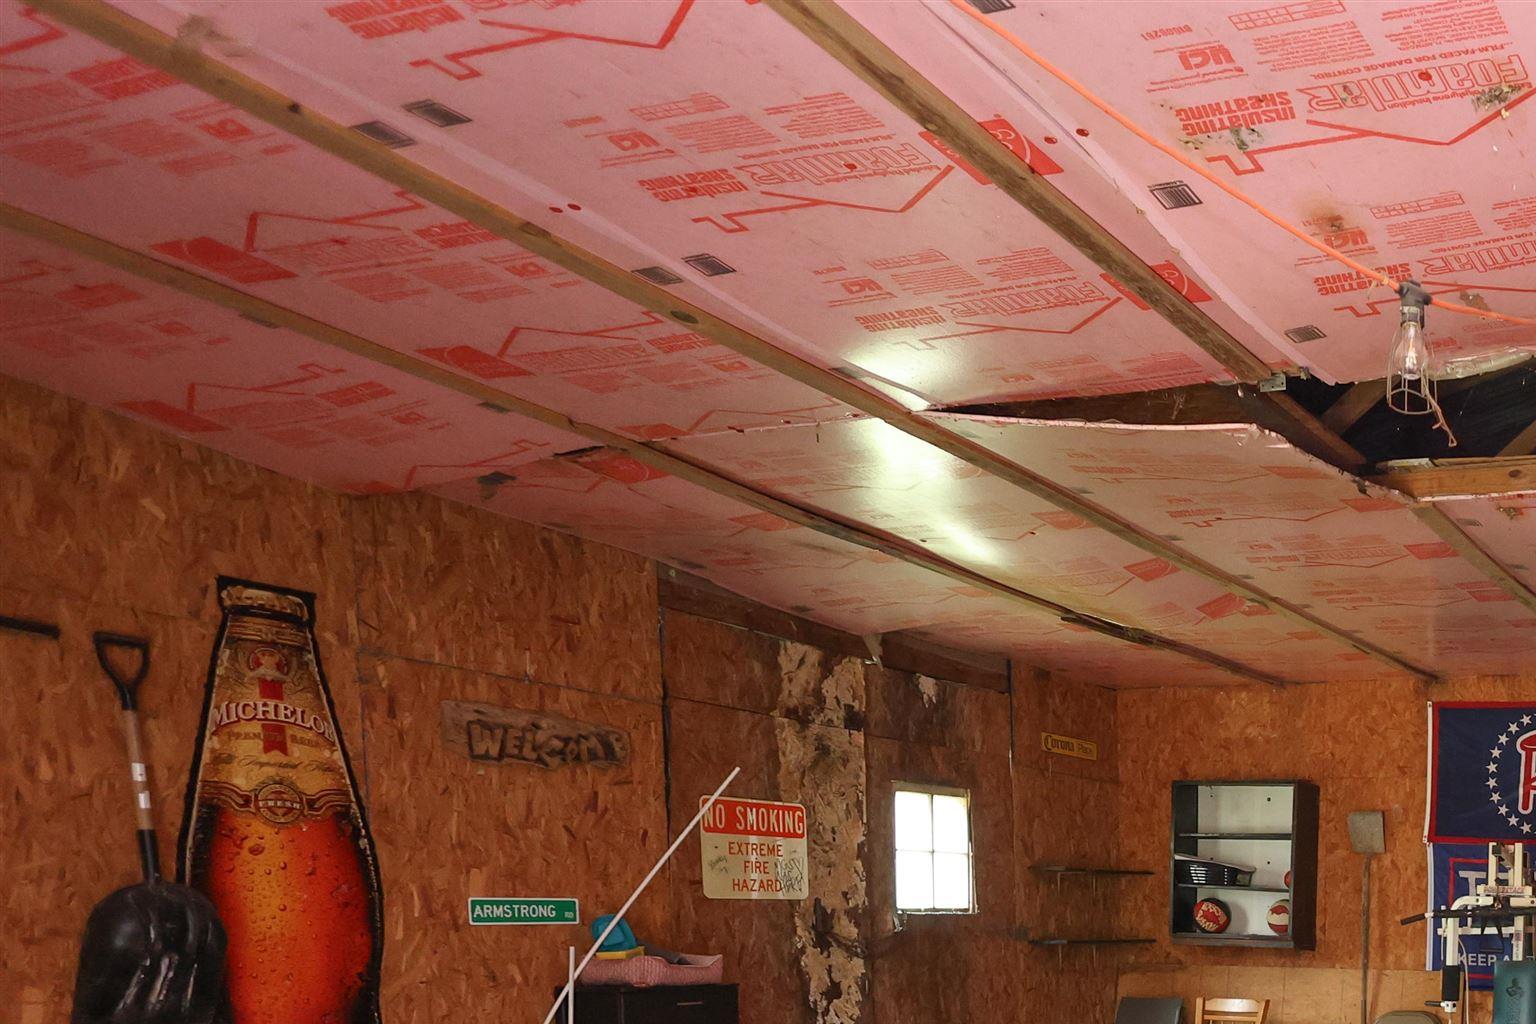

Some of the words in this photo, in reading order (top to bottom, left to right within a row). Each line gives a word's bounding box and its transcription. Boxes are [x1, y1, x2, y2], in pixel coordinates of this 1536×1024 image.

[704, 804, 726, 829] NO
[736, 806, 804, 834] SMOKING
[728, 842, 783, 857] EXTREME
[743, 861, 769, 874] FIRE
[732, 879, 783, 892] HAZARD
[473, 904, 556, 918] ARMSTRONG
[1458, 953, 1497, 966] KEEP
